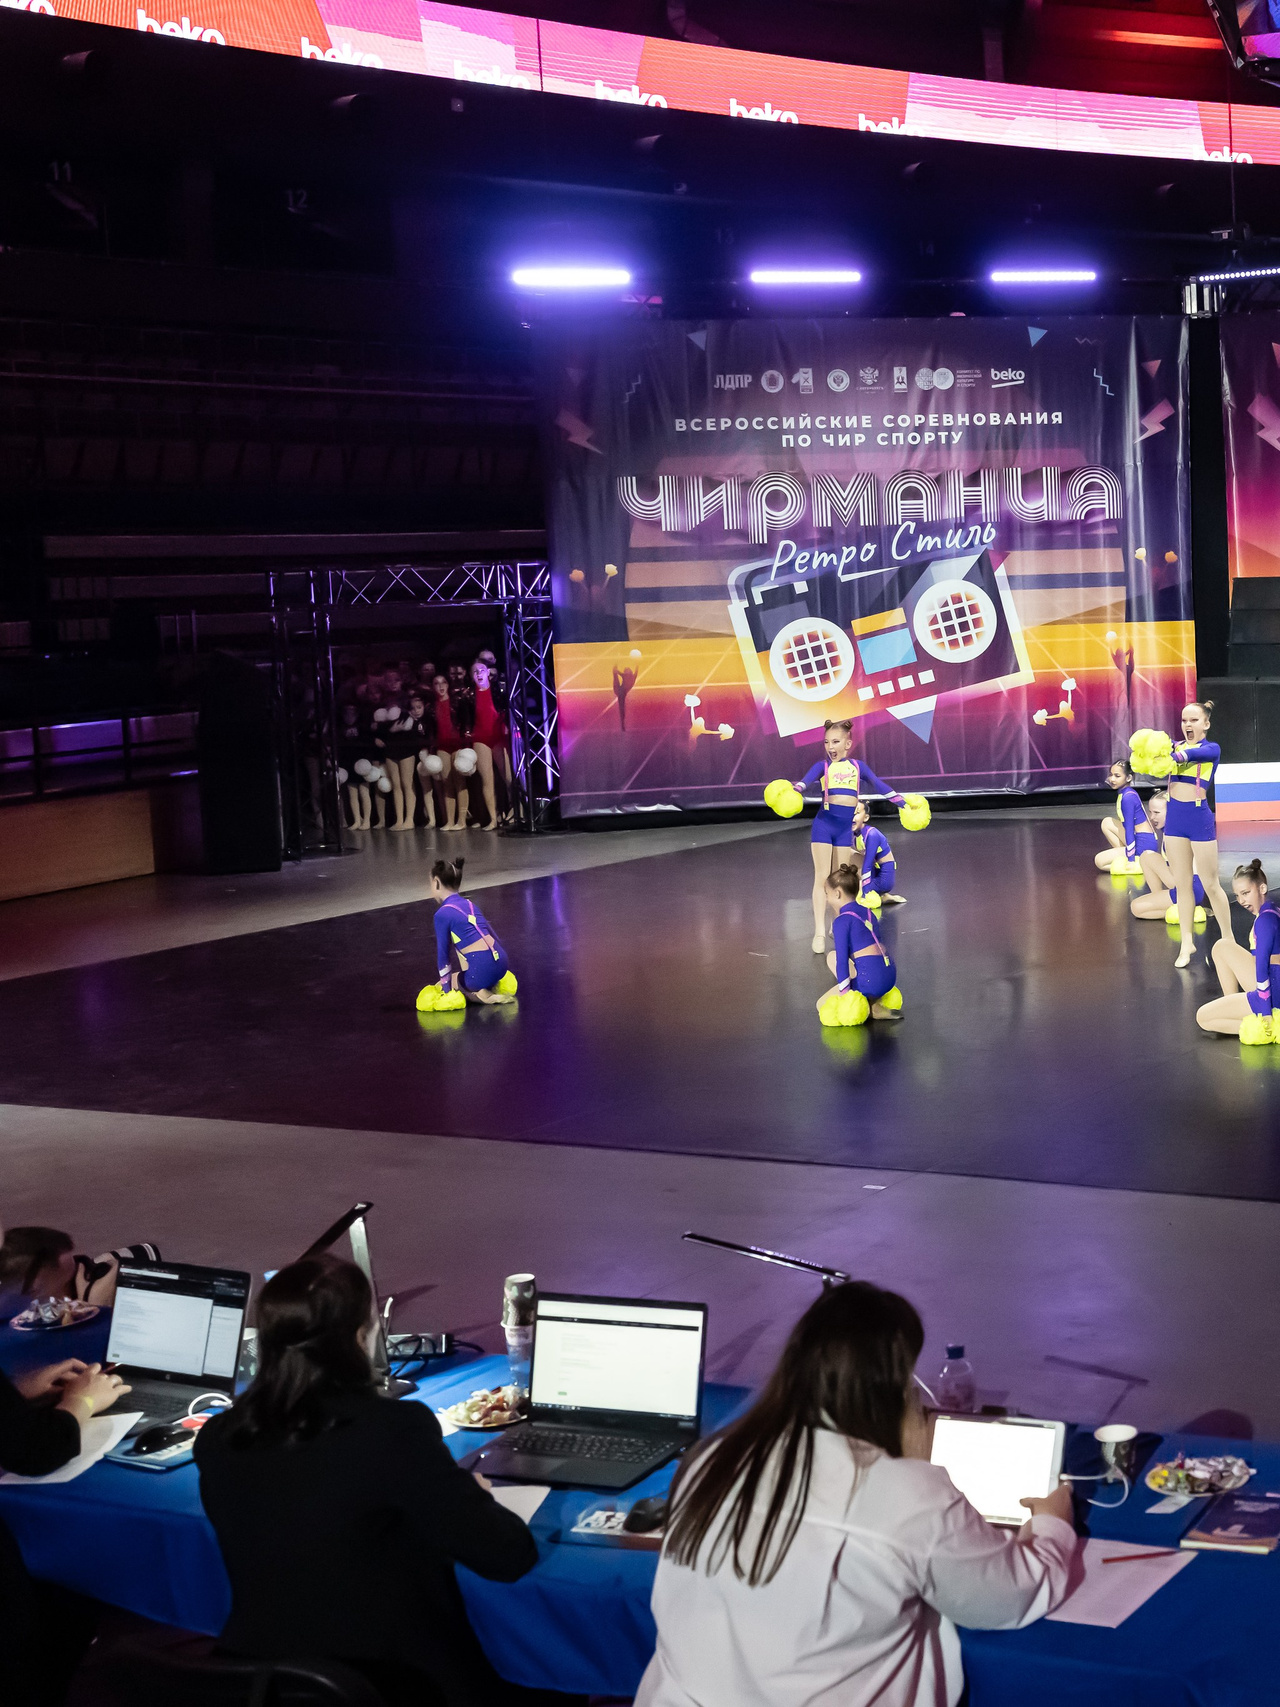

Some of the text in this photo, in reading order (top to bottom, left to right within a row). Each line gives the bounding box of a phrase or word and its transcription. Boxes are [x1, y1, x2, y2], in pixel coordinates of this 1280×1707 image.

[713, 374, 752, 391] ЛДПР
[990, 368, 1026, 381] beko
[675, 411, 1063, 431] ВСЕРОССИЙСКИЕ СОРЕВНОВАНИЯ
[781, 431, 963, 447] ПО ЧИР СПОРТУ
[770, 520, 997, 582] Ретро Стиль
